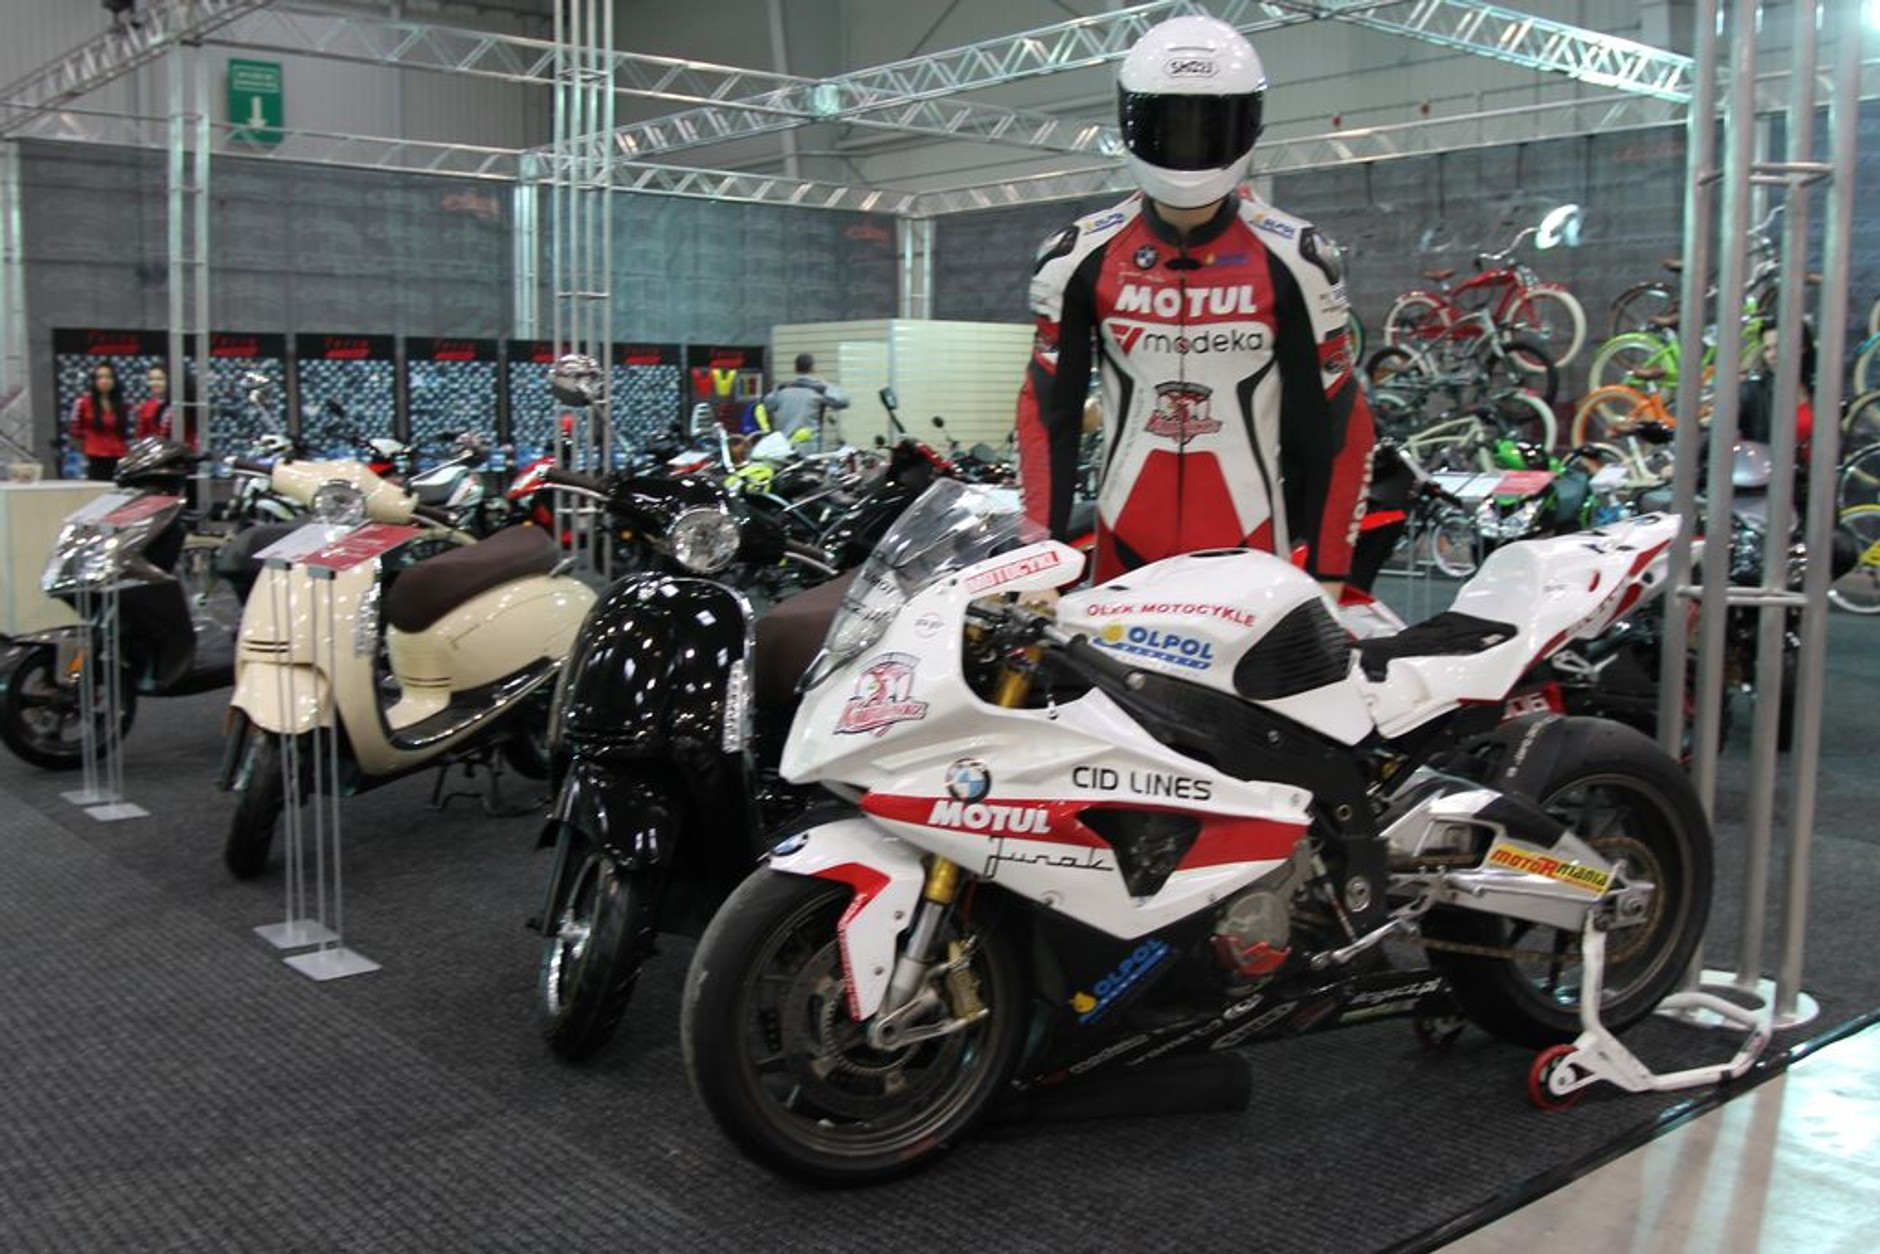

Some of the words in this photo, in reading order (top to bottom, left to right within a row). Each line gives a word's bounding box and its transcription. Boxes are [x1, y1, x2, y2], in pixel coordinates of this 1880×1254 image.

[1114, 285, 1257, 318] MOTUL
[1144, 329, 1264, 355] modeka
[1141, 603, 1257, 627] MOTOCYKLE
[1128, 626, 1213, 659] OLPOL
[1072, 766, 1119, 791] CID
[1130, 771, 1213, 801] LINES
[928, 800, 1052, 834] MOTUL
